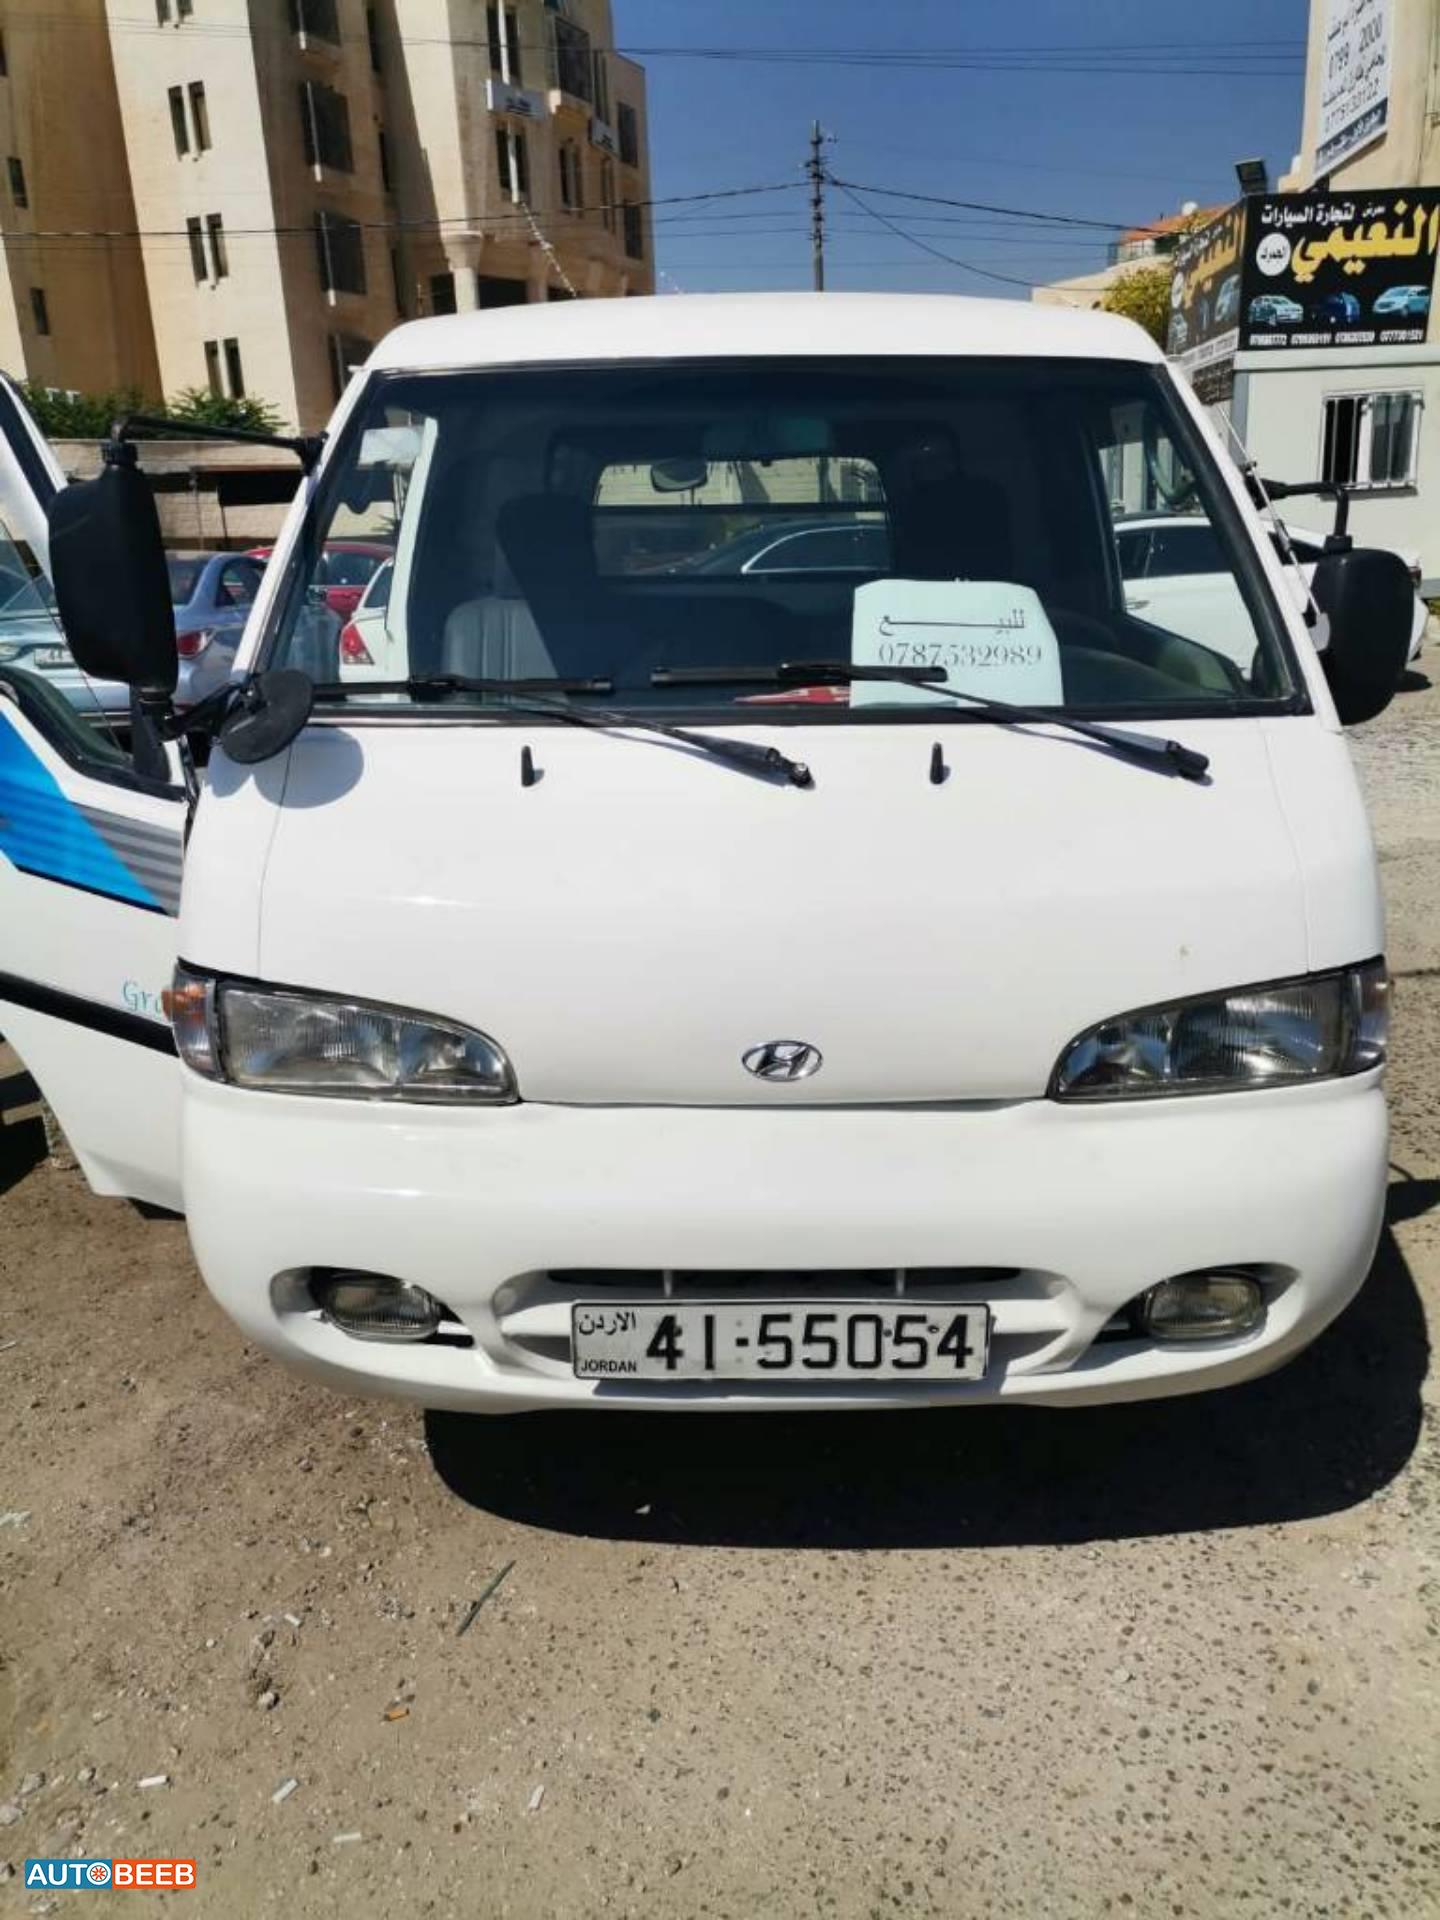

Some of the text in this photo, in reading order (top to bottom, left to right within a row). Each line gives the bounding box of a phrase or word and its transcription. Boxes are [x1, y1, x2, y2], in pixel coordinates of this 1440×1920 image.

[1261, 203, 1314, 228] السيارات
[1316, 201, 1356, 227] لتجارة
[1291, 199, 1440, 283] النعيمي
[878, 643, 1042, 667] 0787532989
[580, 1358, 637, 1373] JORDAN
